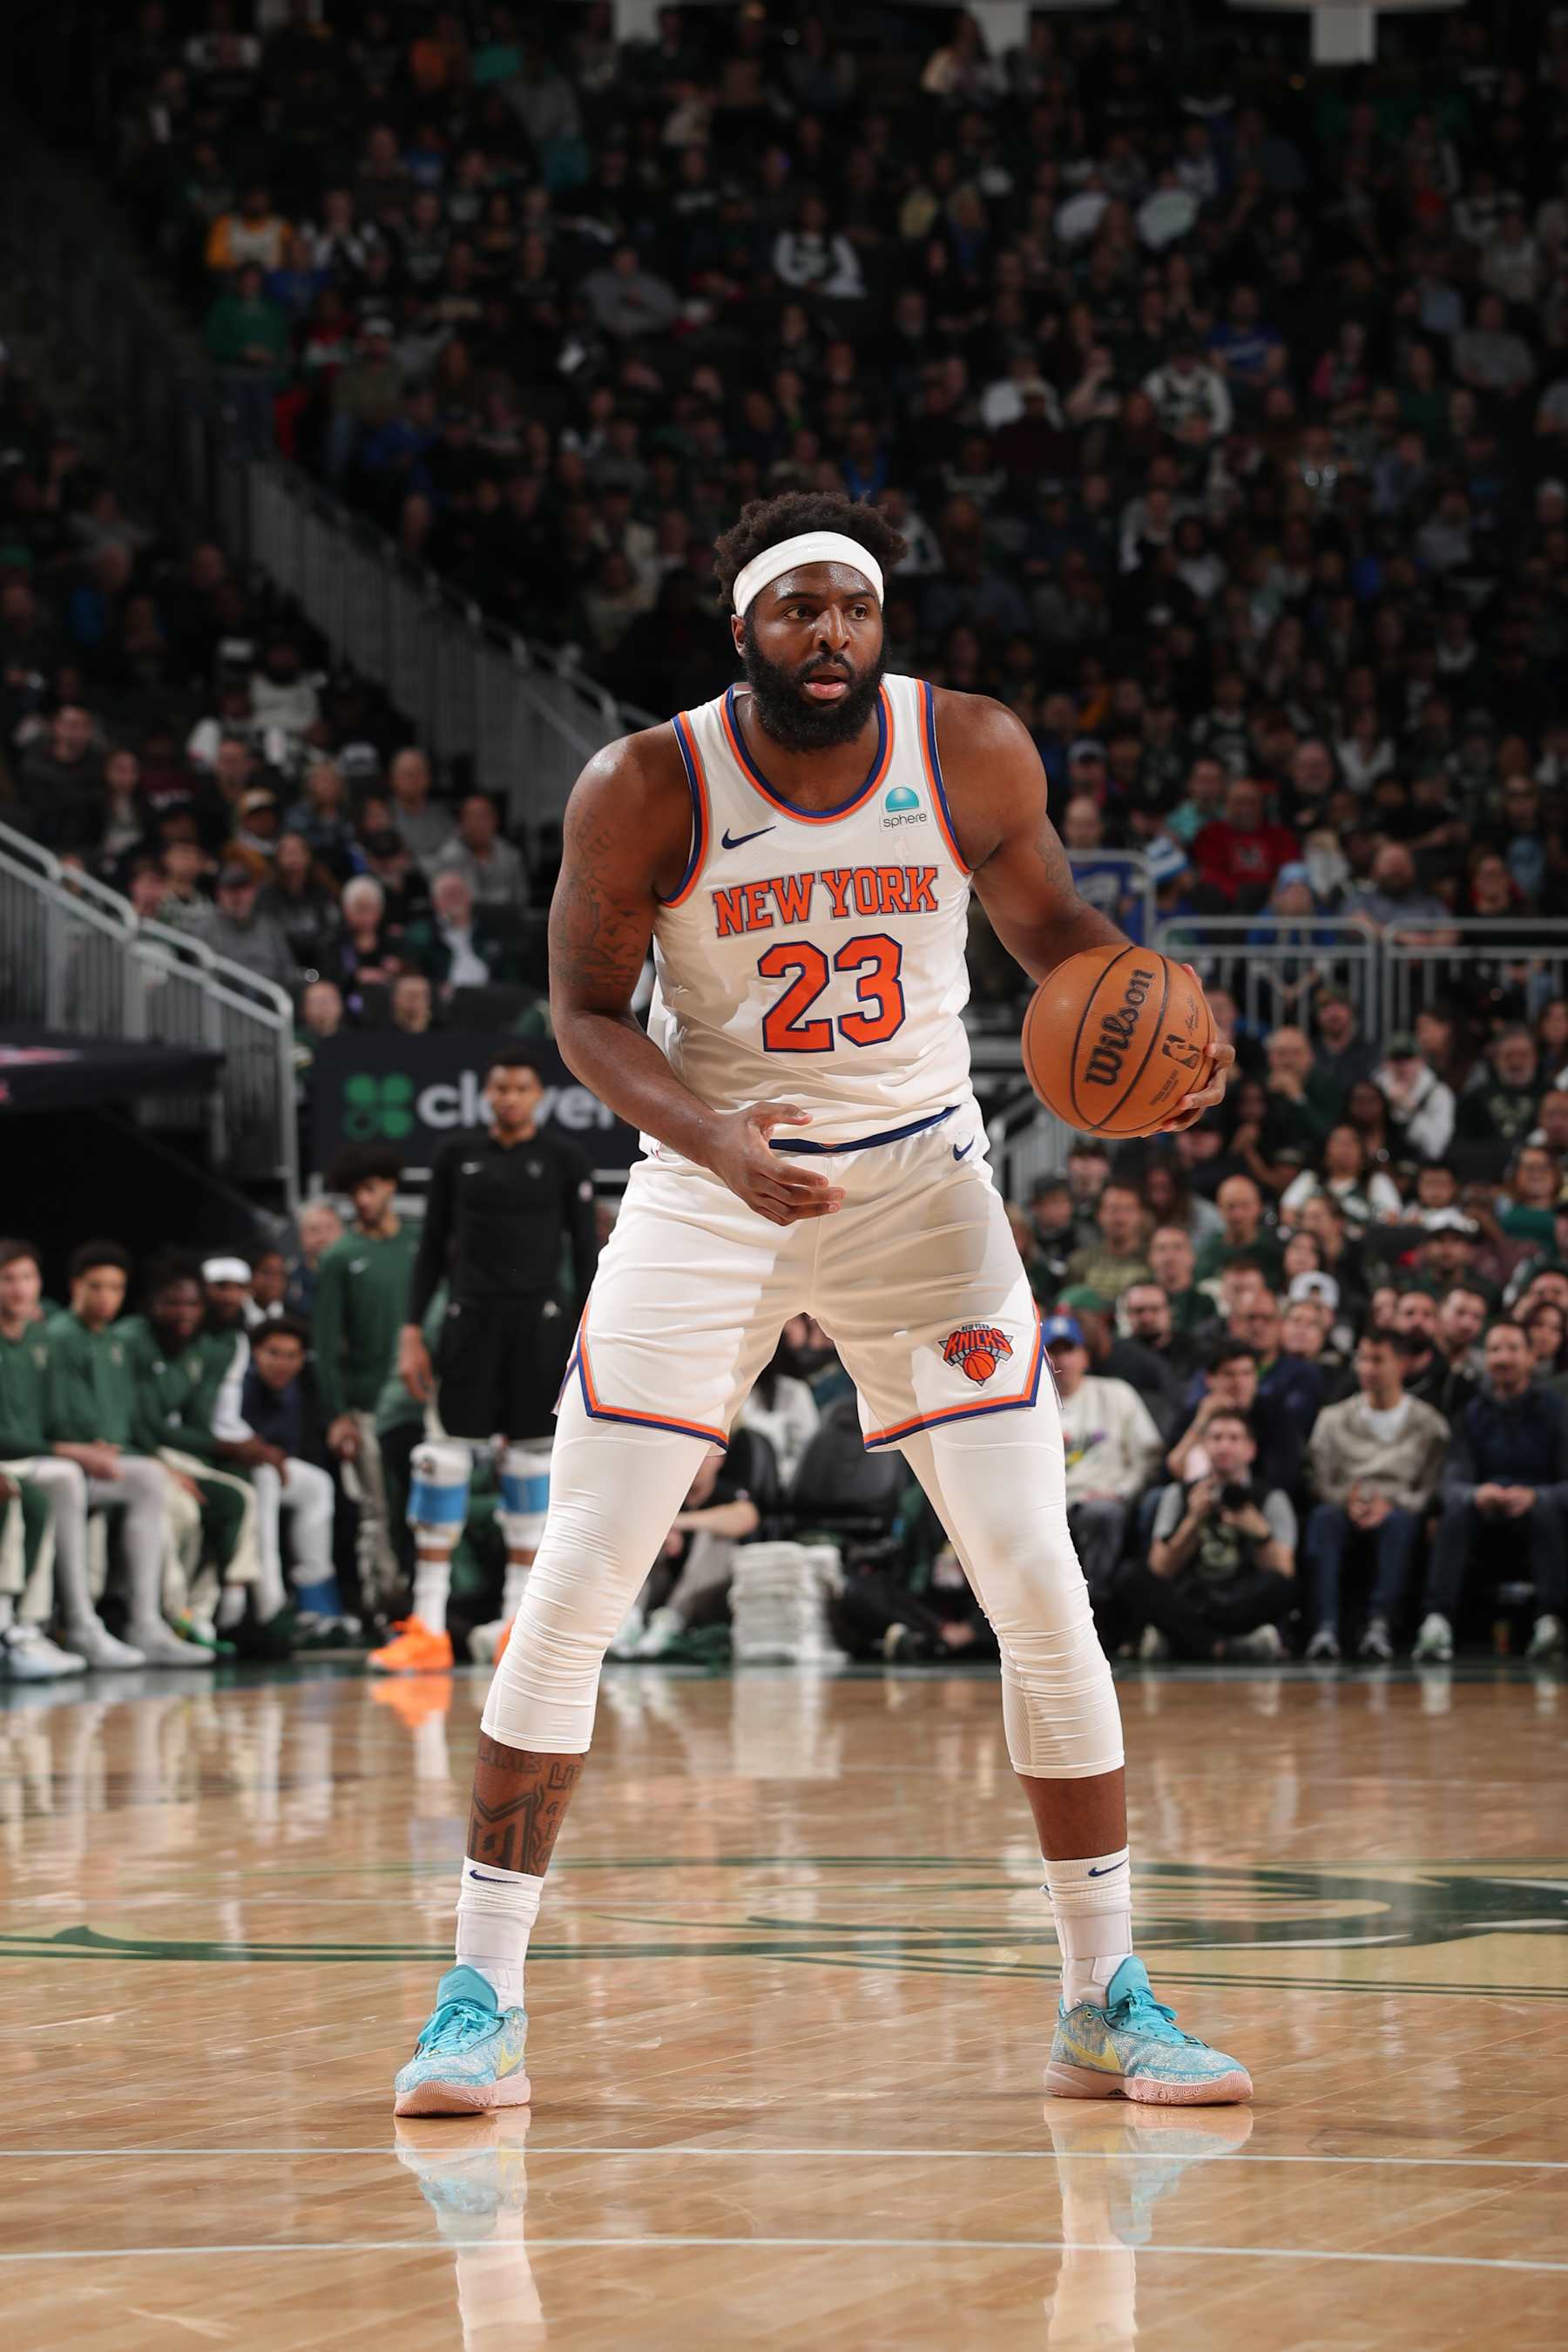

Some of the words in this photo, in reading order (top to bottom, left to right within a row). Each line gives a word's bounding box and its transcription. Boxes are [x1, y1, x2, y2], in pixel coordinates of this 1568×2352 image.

[883, 813, 927, 828] sphere
[712, 872, 814, 938] NEW
[821, 866, 938, 919] YORK
[757, 933, 906, 1052] 23
[1085, 969, 1156, 1087] Wilson
[943, 1328, 1014, 1362] KNICKS
